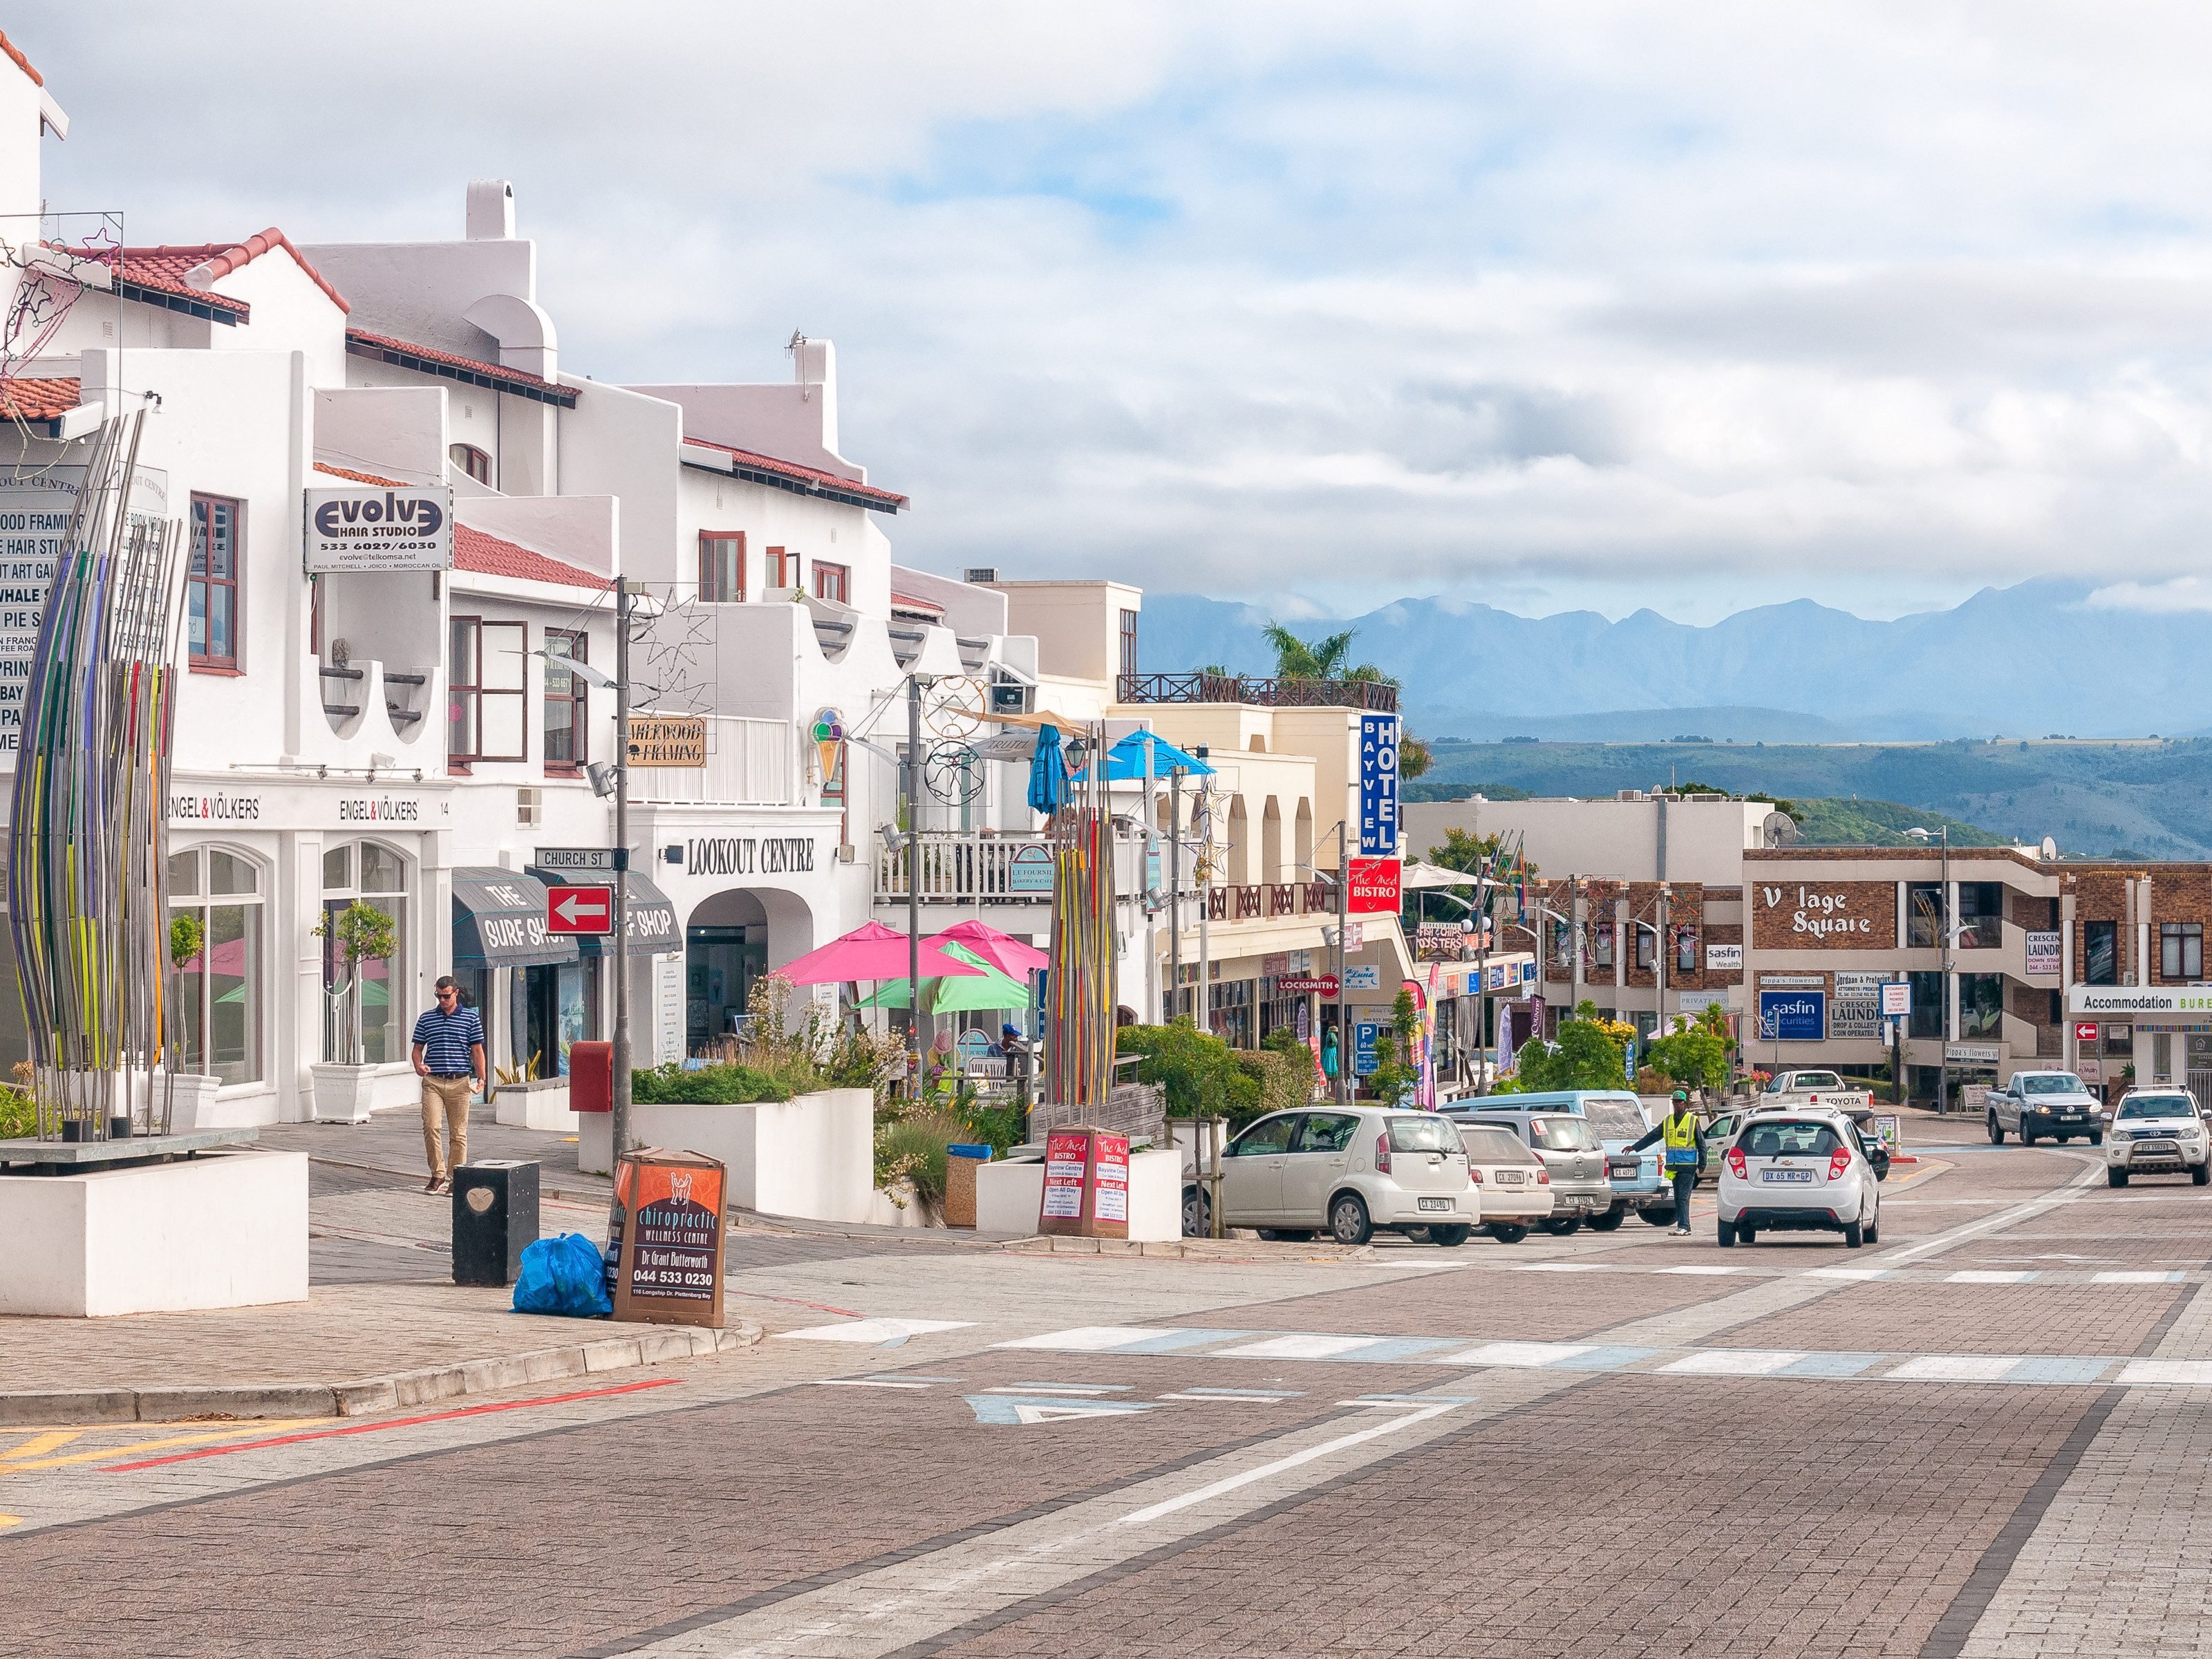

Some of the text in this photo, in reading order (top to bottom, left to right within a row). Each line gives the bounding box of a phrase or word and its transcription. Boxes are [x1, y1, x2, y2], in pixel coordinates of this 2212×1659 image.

[340, 526, 417, 537] HAIR STUDIO
[7, 539, 35, 554] HAIR
[353, 542, 437, 550] 6029/6030
[12, 564, 33, 579] ART
[4, 612, 26, 628] PIE
[629, 724, 701, 740] MILKWOOD
[986, 740, 1029, 749] TRUTH
[643, 744, 701, 761] FRAMING
[1362, 722, 1376, 848] BAYVIEW
[1378, 722, 1395, 849] HOTEL
[440, 802, 449, 816] 14
[544, 852, 604, 865] CHURCH ST
[687, 837, 814, 876] LOOKOUT CENTRE
[1352, 873, 1397, 885] The Med
[485, 885, 527, 907] THE
[1353, 886, 1396, 897] BISTRO
[636, 909, 672, 937] SHOP
[485, 919, 525, 948] SURF
[1419, 926, 1434, 937] FISH
[1440, 927, 1463, 939] CHIPS
[1418, 937, 1463, 949] OYSTERS
[1708, 946, 1741, 958] sasfin
[2028, 944, 2059, 956] LAUNDR
[1349, 969, 1374, 978] Luna
[1836, 973, 1857, 986] Jordaan
[1859, 975, 1864, 984] &
[1280, 981, 1333, 989] LOCKSMITH
[1772, 1000, 1815, 1015] sasfin
[2083, 995, 2172, 1009] Accommodation
[1361, 1027, 1373, 1040] P
[1825, 1097, 1862, 1105] TOYOTA
[1533, 1121, 1547, 1135] L
[1105, 1154, 1123, 1163] BISTRO
[1063, 1178, 1078, 1186] Left
[1499, 1173, 1505, 1181] CX
[1765, 1172, 1774, 1180] DX
[1800, 1172, 1809, 1180] GP
[1100, 1179, 1116, 1189] Next
[1421, 1200, 1446, 1209] CX 23480
[1568, 1196, 1576, 1204] CX
[639, 1206, 716, 1230] chiropractic
[645, 1229, 709, 1245] WELLNESS CENTRE
[641, 1250, 708, 1269] Dr Grant Butterworth
[633, 1269, 713, 1286] 044 533 0230
